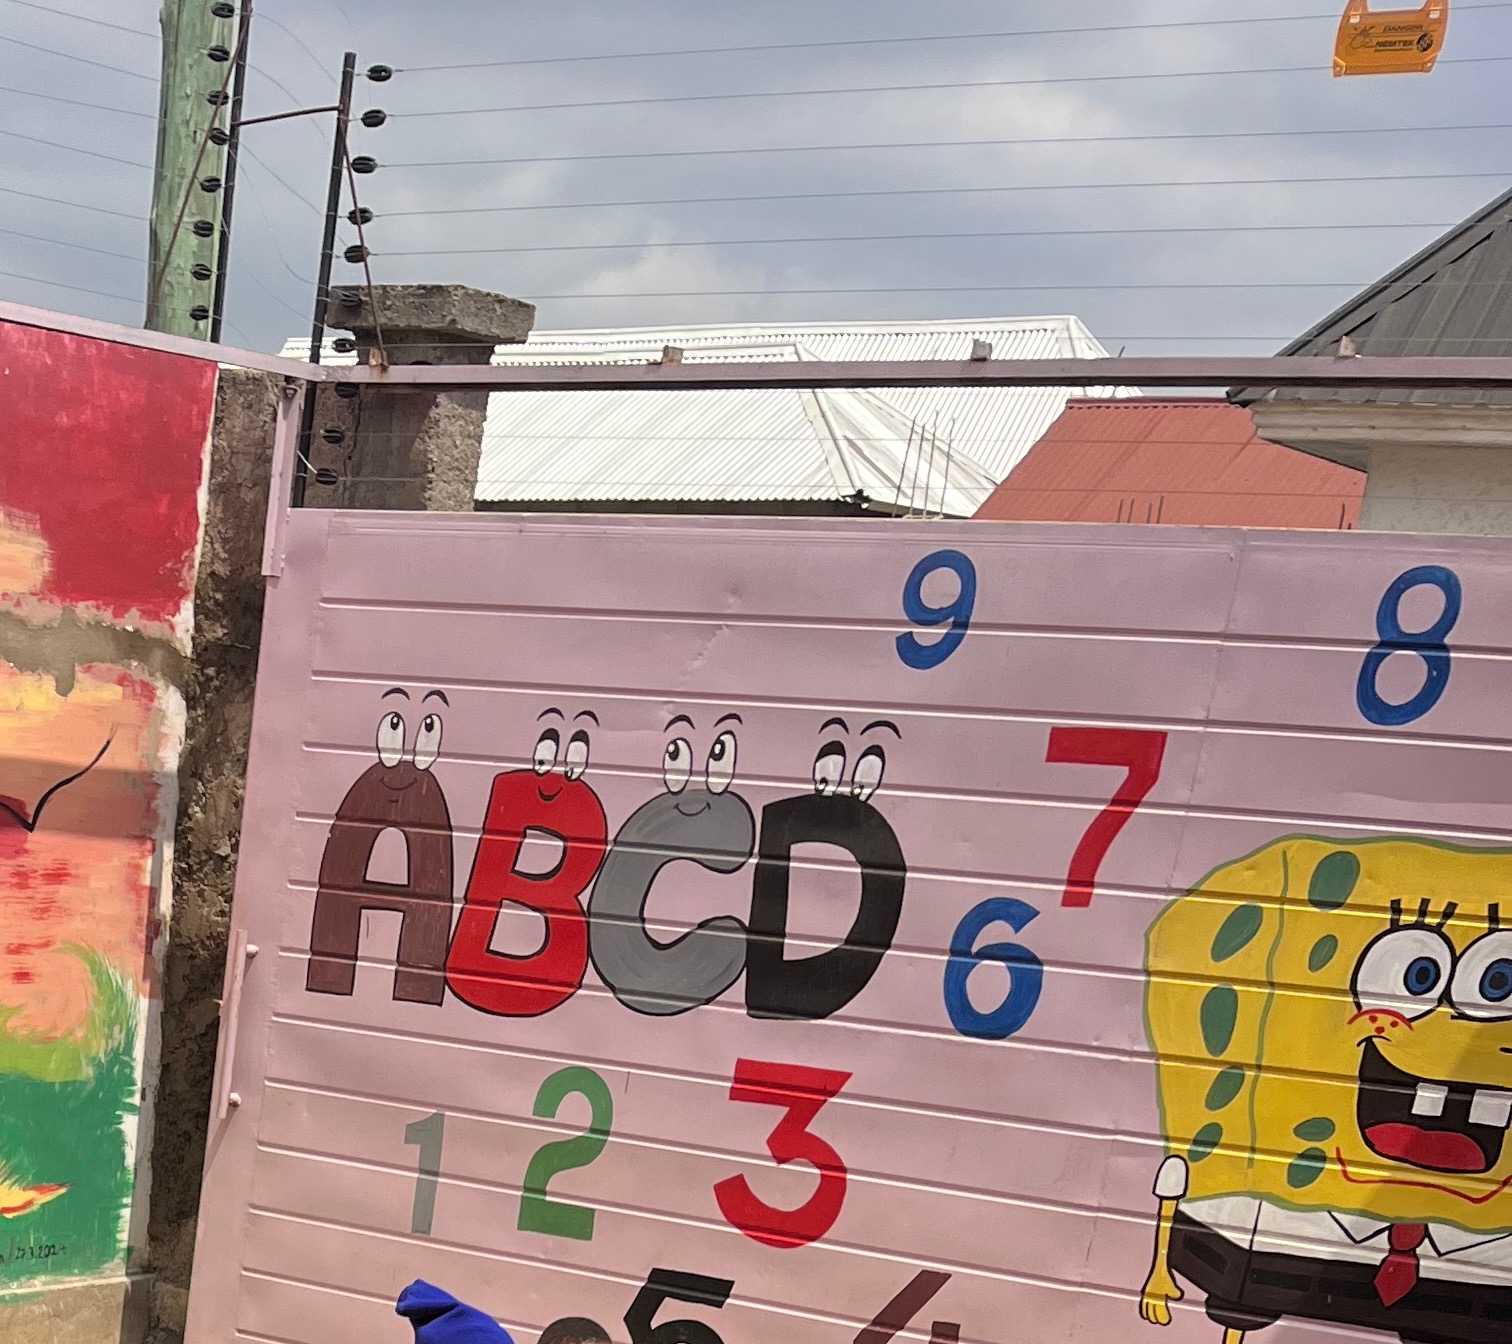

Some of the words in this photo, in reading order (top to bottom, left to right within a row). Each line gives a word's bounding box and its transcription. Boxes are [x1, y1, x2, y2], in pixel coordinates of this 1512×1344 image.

[895, 549, 977, 670] 9
[1356, 565, 1462, 727] 8
[1044, 726, 1169, 909] 7
[943, 897, 1044, 1040] 6
[403, 1111, 445, 1237] 1
[517, 1065, 614, 1241] 2
[713, 1057, 853, 1249] 3
